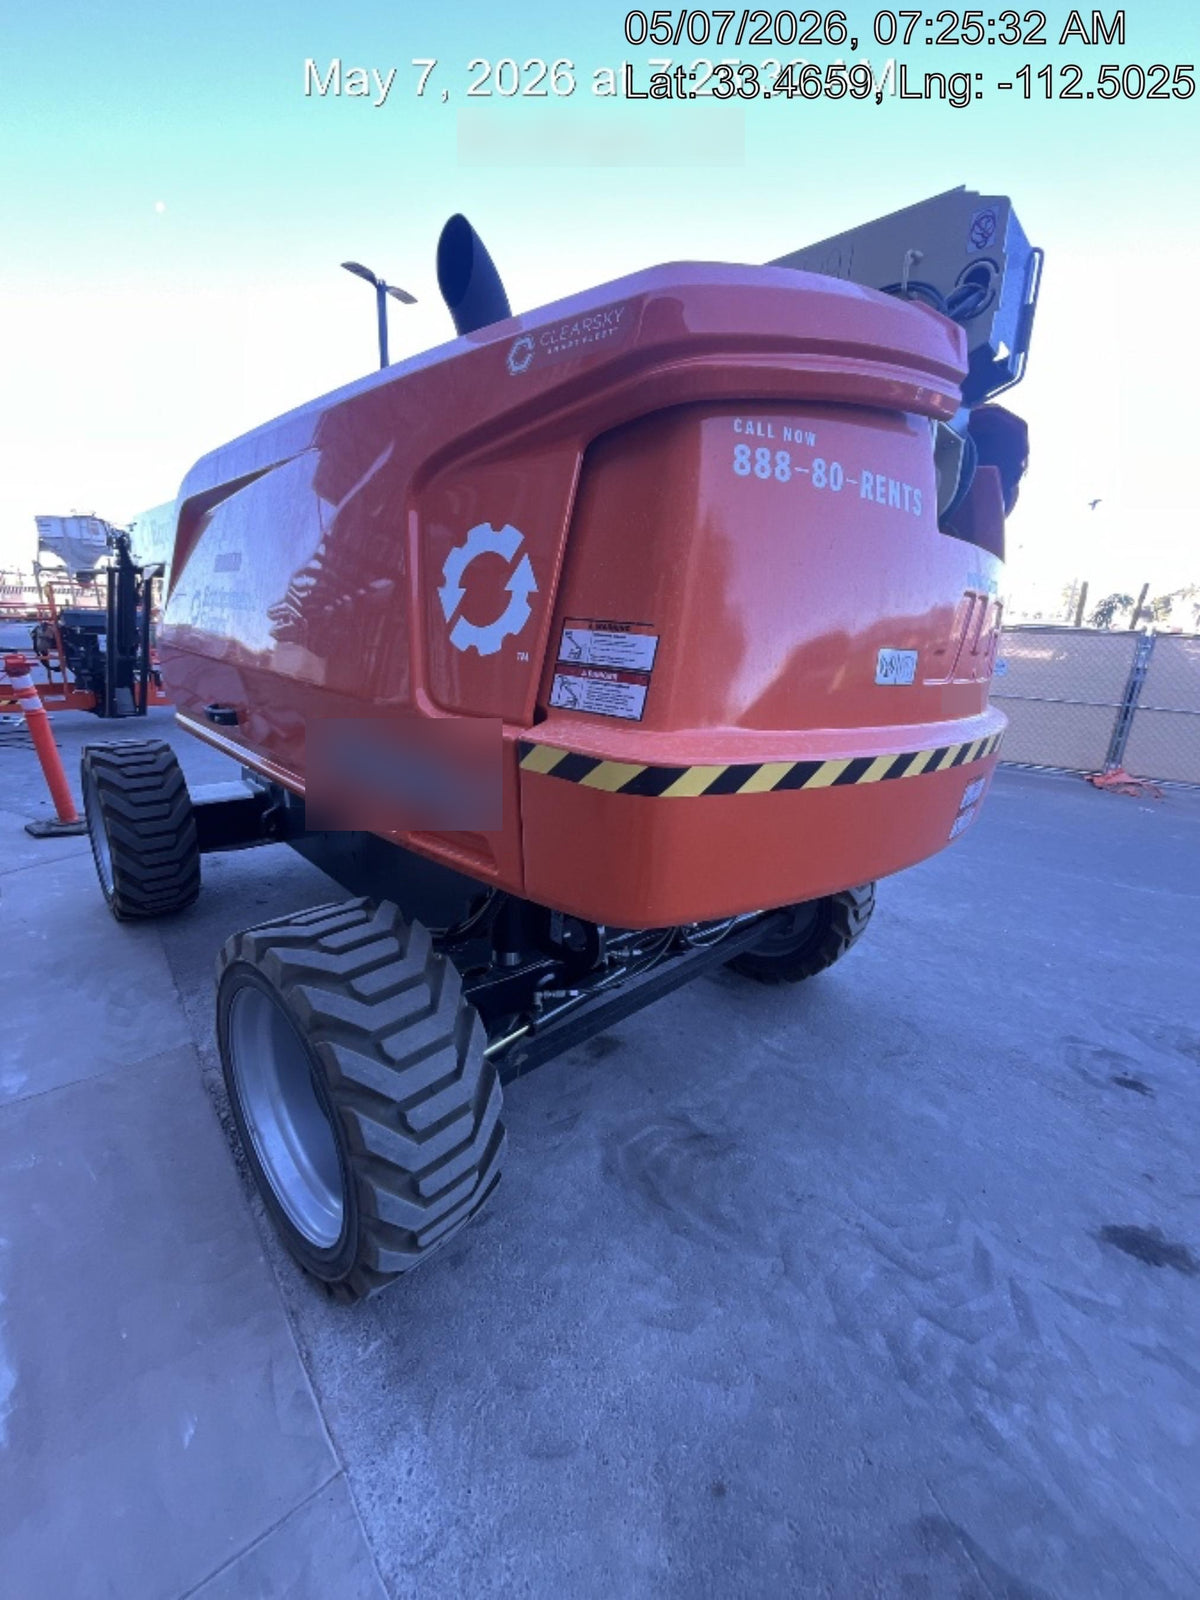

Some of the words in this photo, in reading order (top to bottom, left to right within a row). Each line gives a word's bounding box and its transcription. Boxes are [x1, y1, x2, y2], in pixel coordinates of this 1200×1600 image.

[733, 418, 776, 439] CALL
[782, 426, 817, 447] NOW
[732, 443, 923, 517] 888-80-RENTS
